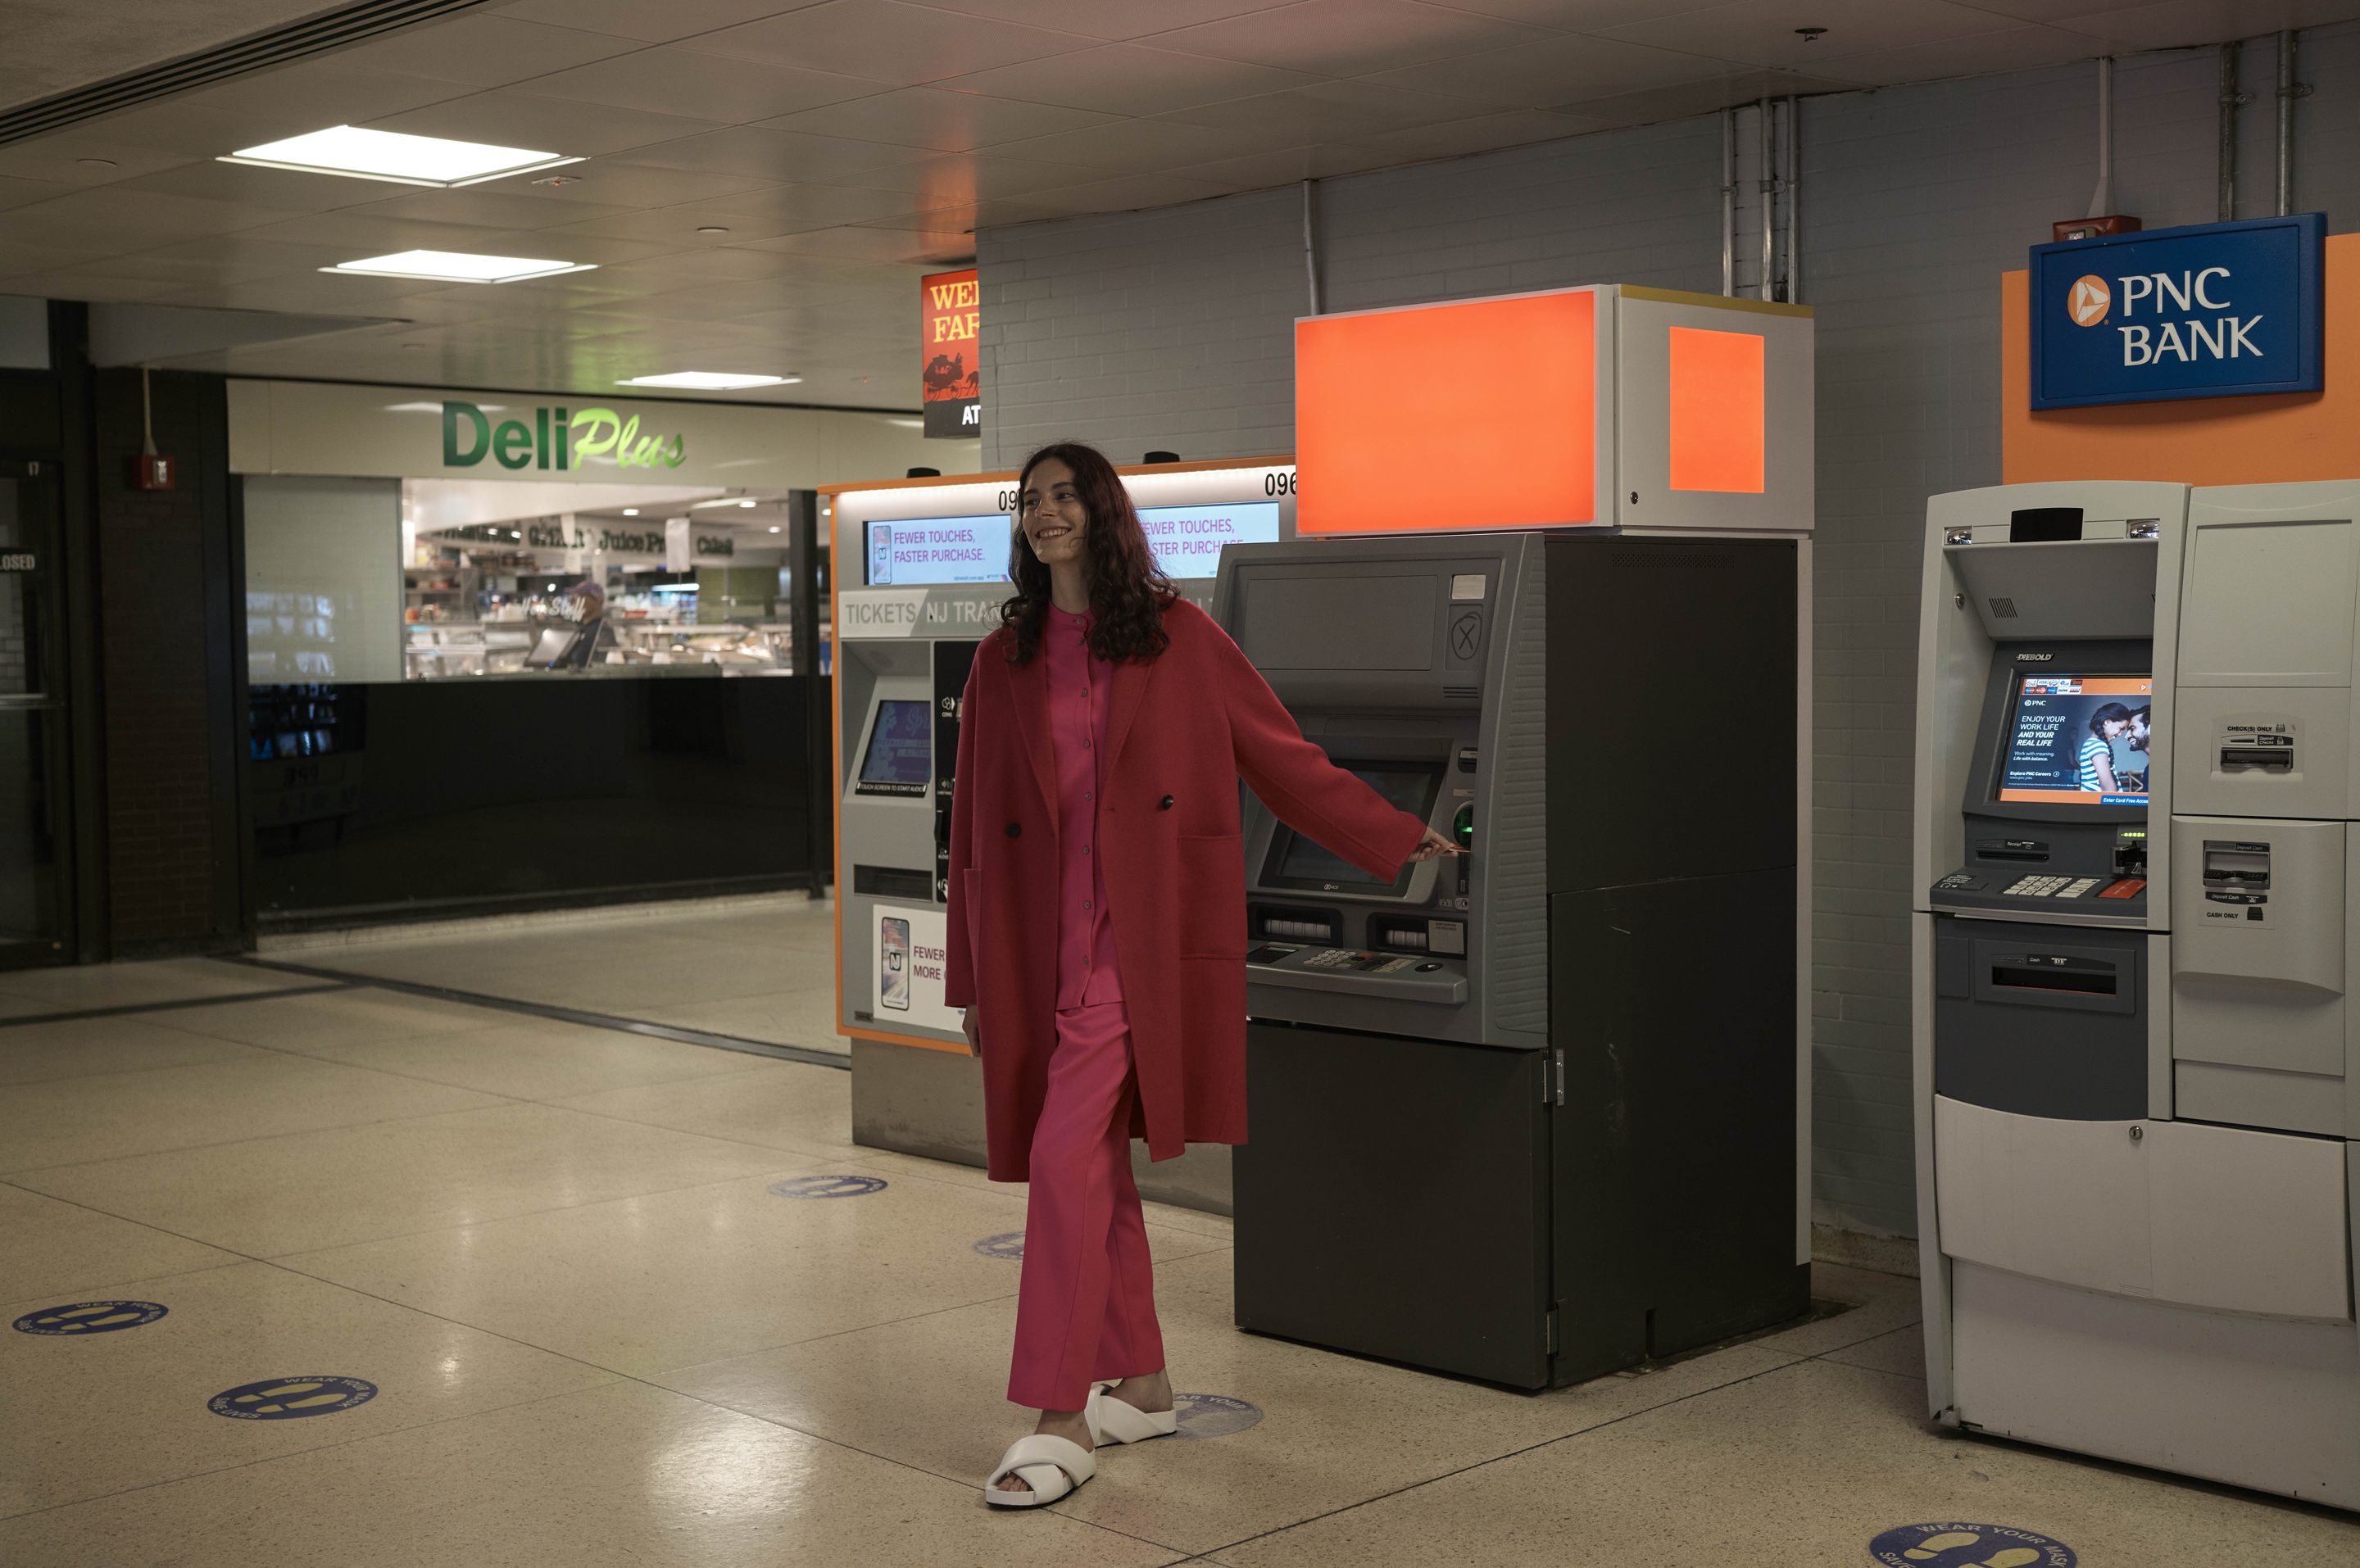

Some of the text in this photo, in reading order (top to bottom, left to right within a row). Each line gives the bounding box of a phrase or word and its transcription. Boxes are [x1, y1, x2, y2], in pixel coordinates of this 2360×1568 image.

[2118, 267, 2231, 316] PNC
[2117, 315, 2264, 366] BANK
[442, 401, 687, 472] Deli Plus
[1178, 519, 1235, 534] TOUCHES,
[598, 529, 644, 551] Juice
[895, 529, 976, 545] FEWER TOUCHES,
[894, 548, 986, 563] FASTER PURCHASE.
[1150, 540, 1244, 555] STER PURCH
[0, 554, 35, 571] OSED
[845, 602, 916, 624] TICKETS
[926, 601, 948, 623] NJ
[2017, 653, 2053, 661] DIEBOLD
[914, 945, 946, 962] FEWER
[914, 965, 942, 981] MORE
[341, 1379, 370, 1392] YOUR
[1209, 1397, 1247, 1410] YOUR
[221, 1408, 261, 1419] LIVES
[1916, 1524, 2069, 1567] WEAR YOUR MASK
